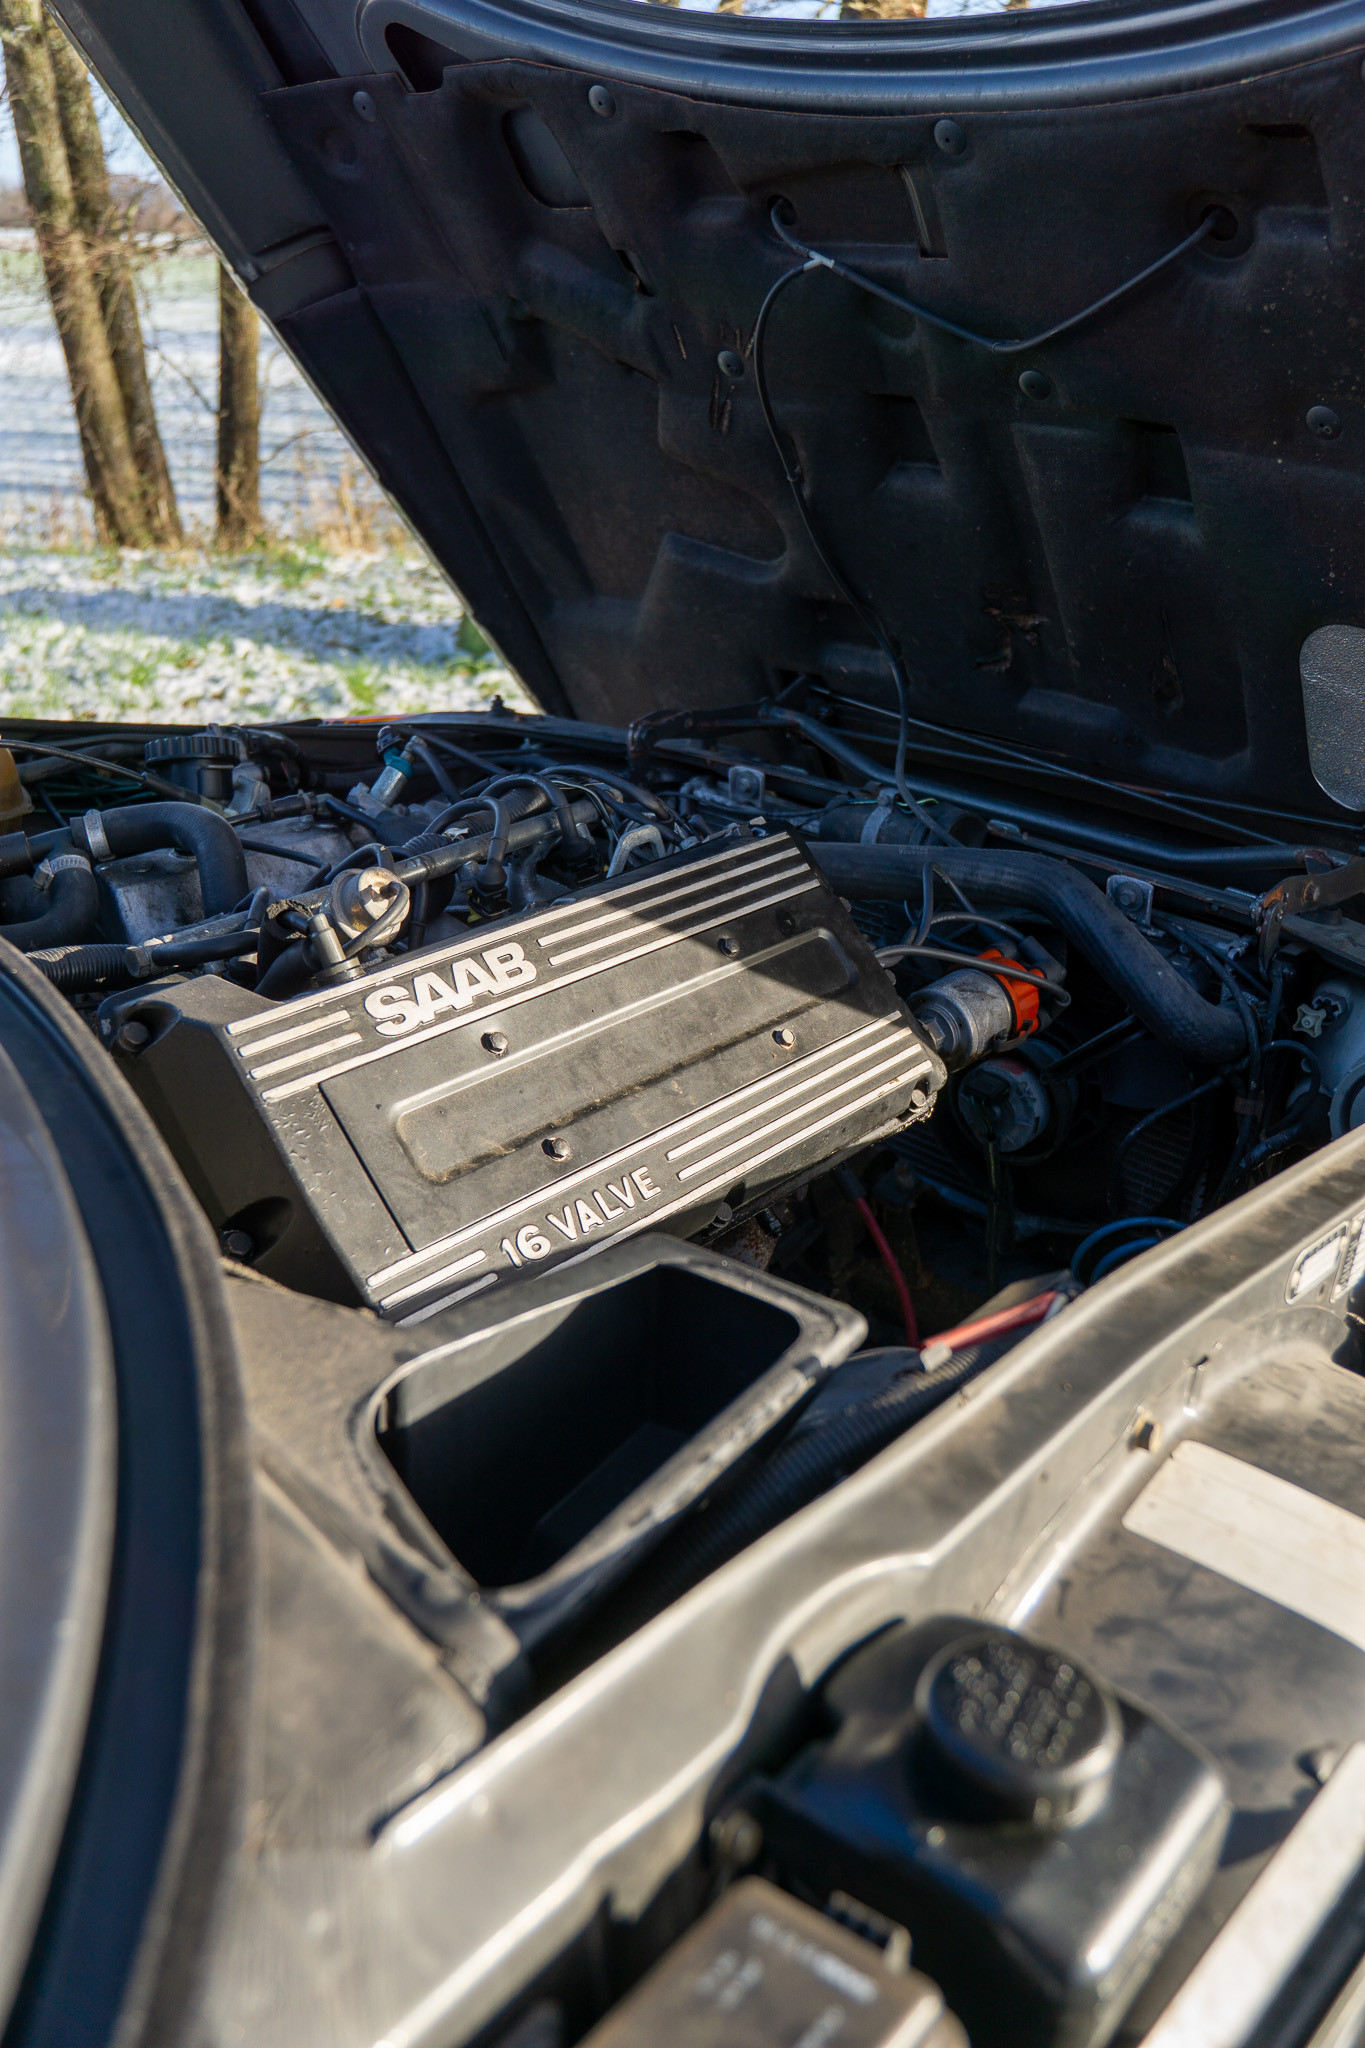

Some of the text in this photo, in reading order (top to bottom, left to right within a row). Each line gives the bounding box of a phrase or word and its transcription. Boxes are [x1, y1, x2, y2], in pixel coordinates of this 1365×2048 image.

[364, 942, 537, 1037] SAAB
[500, 1166, 662, 1268] 16 VALVE
